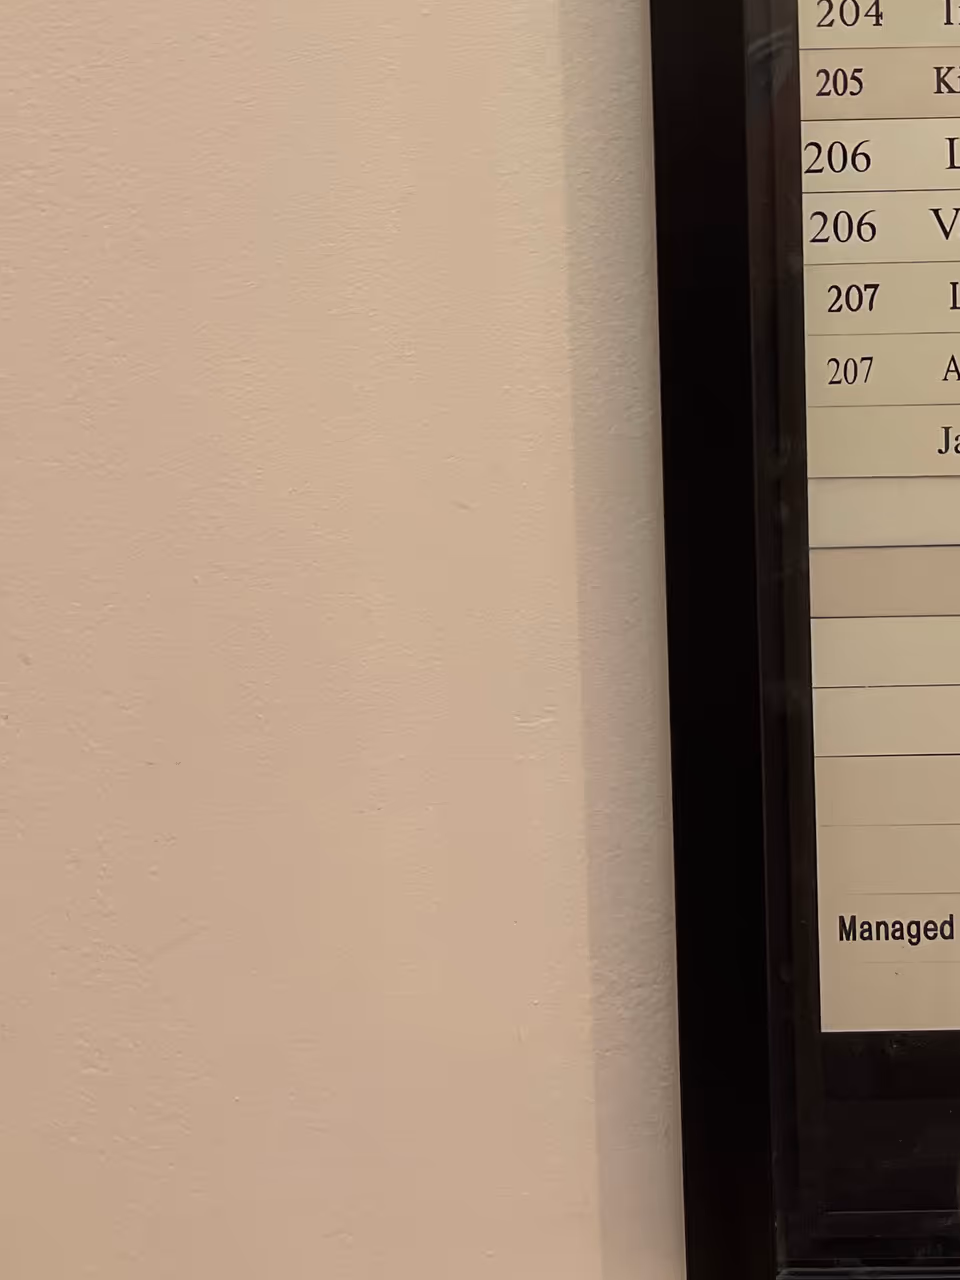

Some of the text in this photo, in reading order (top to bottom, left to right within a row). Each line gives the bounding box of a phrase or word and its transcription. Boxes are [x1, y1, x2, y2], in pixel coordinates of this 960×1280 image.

[815, 67, 864, 97] 205
[803, 139, 871, 174] 206
[809, 209, 877, 243] 206
[827, 283, 880, 313] 207
[826, 356, 874, 385] 207
[838, 913, 955, 947] Managed
